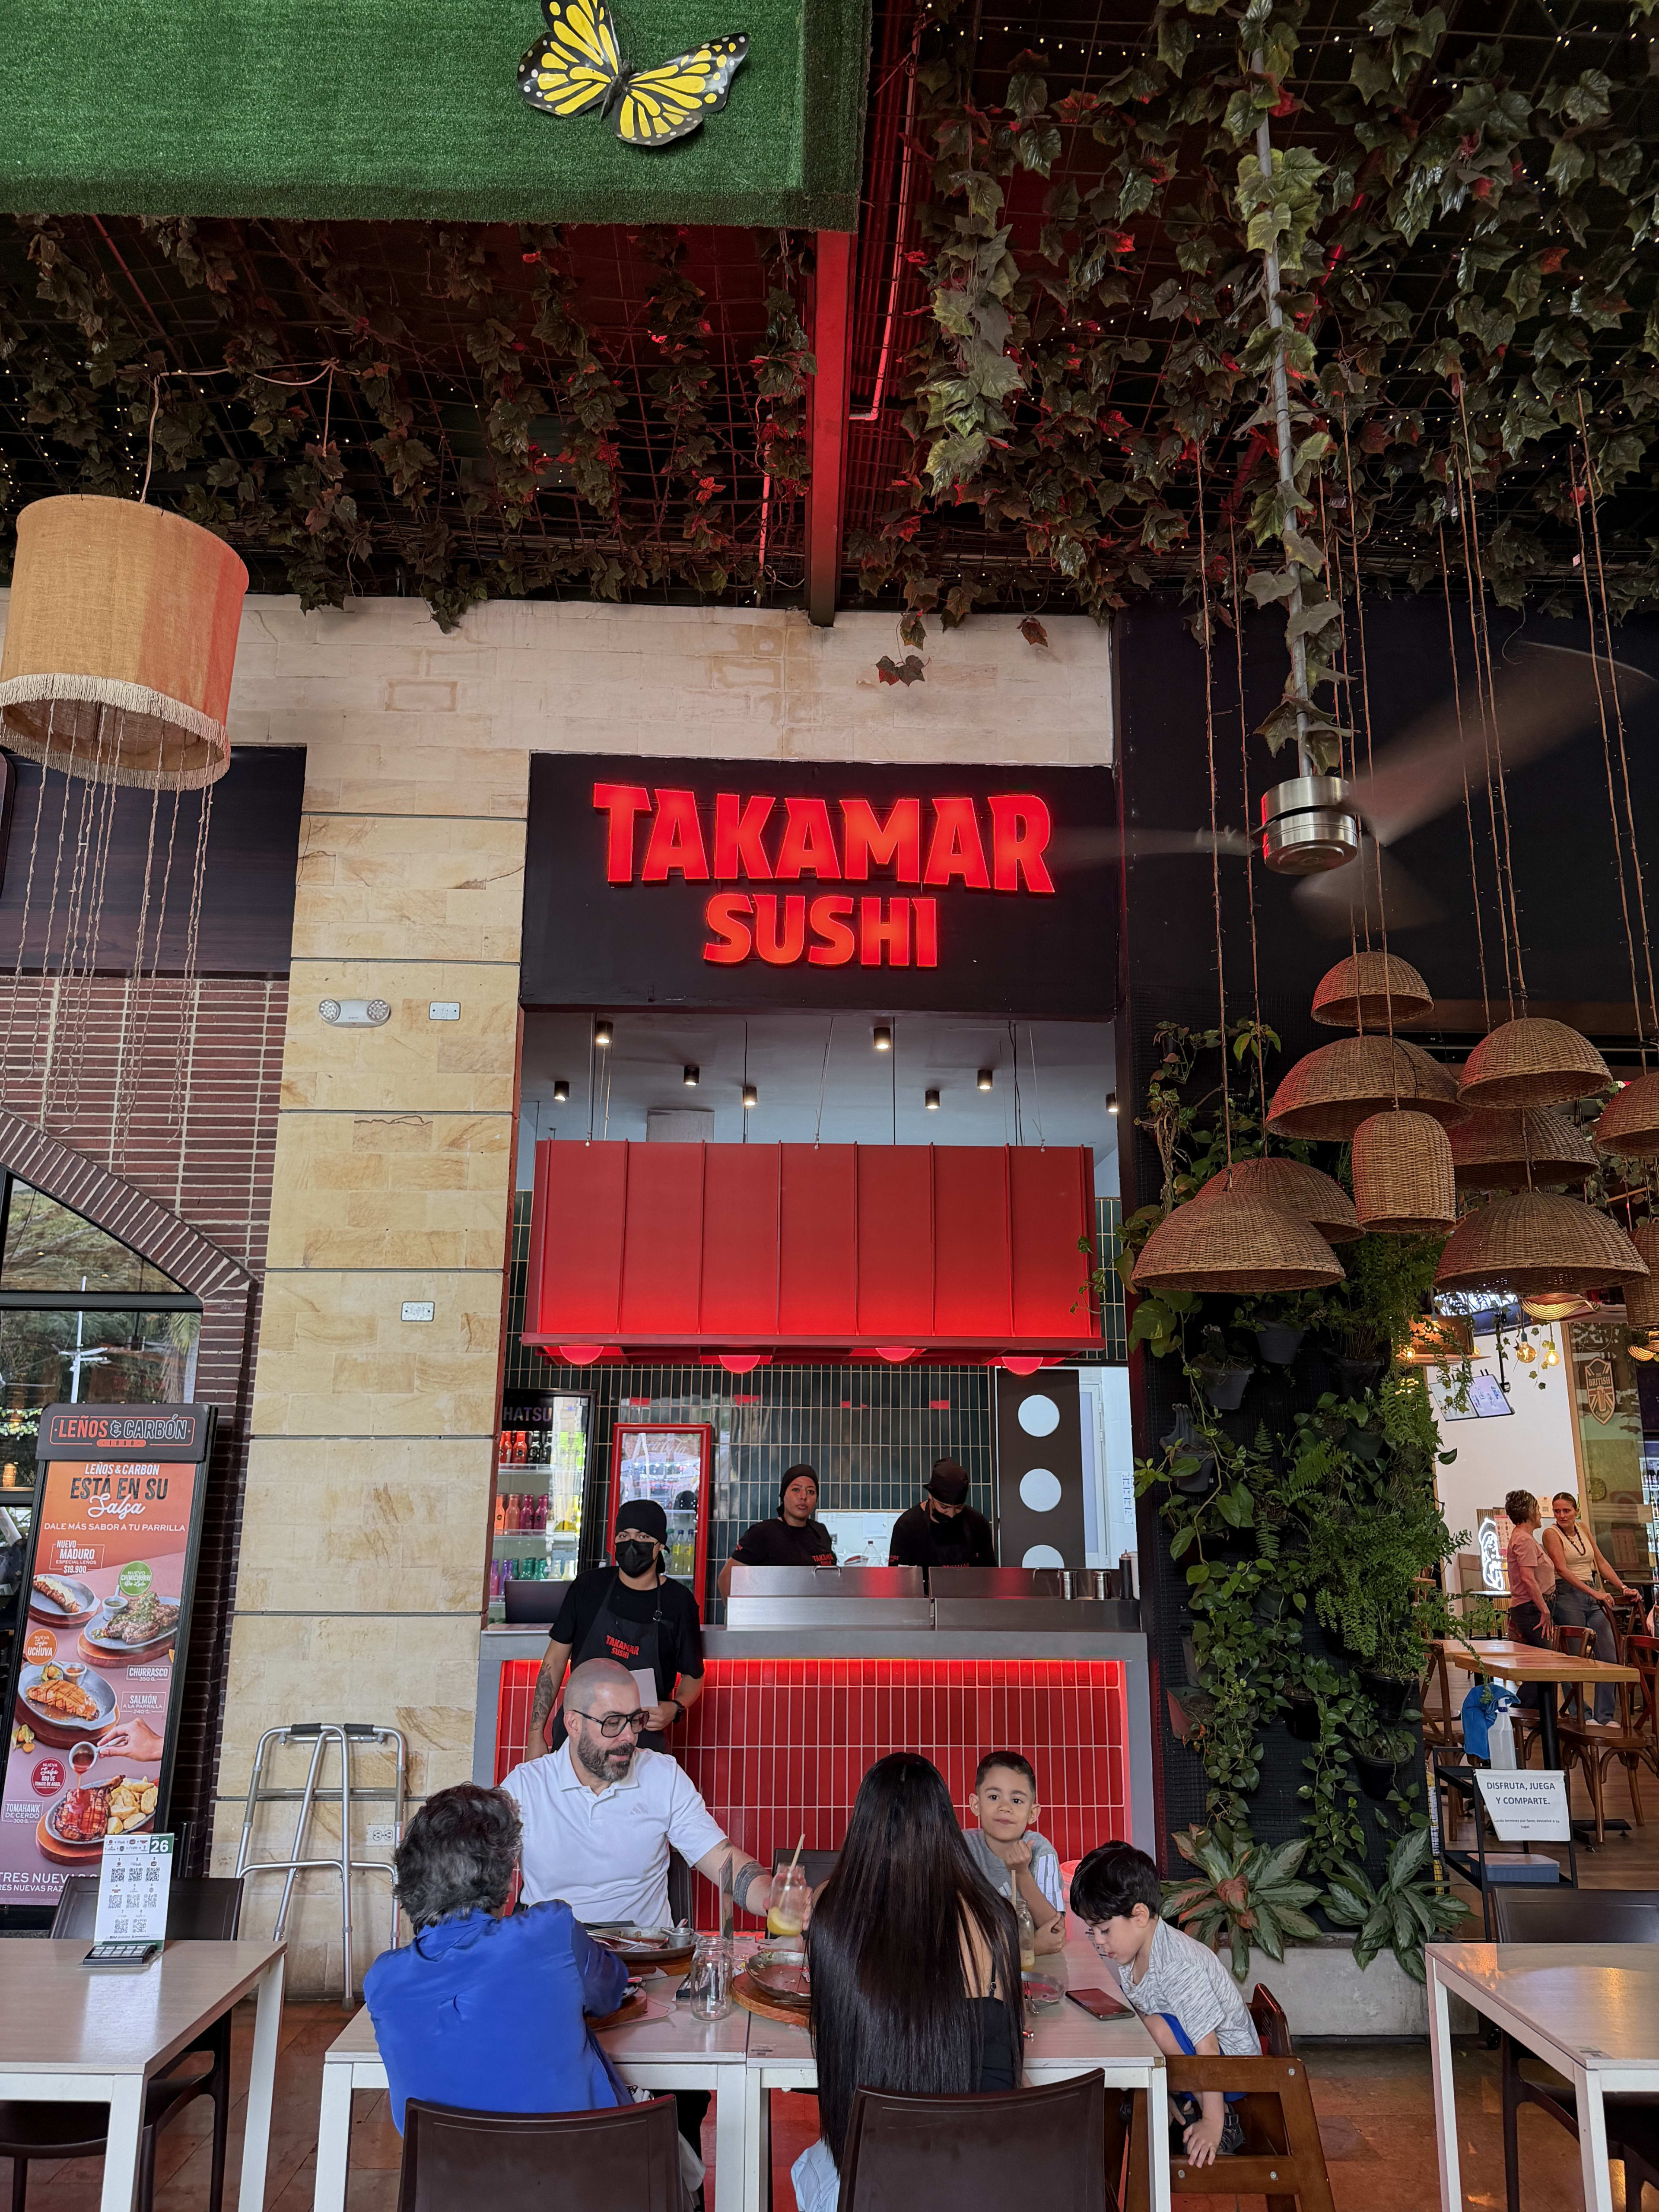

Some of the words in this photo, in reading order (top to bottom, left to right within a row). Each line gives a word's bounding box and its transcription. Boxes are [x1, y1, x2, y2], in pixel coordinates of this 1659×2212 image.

[592, 782, 1055, 894] TAKAMAR
[702, 891, 938, 969] SUSHI
[1589, 1376, 1610, 1386] BRITISH
[503, 1406, 552, 1422] HATSU
[58, 1415, 108, 1438] LEÑOS
[123, 1414, 188, 1440] CARBÓN
[84, 1462, 114, 1475] LEÑOS
[114, 1464, 121, 1474] &
[70, 1475, 111, 1500] ESTÁ
[116, 1478, 141, 1500] EN
[144, 1478, 169, 1500] SU
[87, 1492, 146, 1520] Salsa
[68, 1522, 87, 1531] MÁS
[57, 1540, 76, 1548] NUEVO
[59, 1548, 95, 1560] MADURO
[63, 1565, 87, 1574] $19.900
[27, 1646, 53, 1656] UCHUVA
[606, 1634, 639, 1656] TAKAMAR
[611, 1647, 629, 1659] SUSHI
[129, 1667, 168, 1677] CHURRASCO
[130, 1694, 157, 1704] SALMÓN
[1487, 1782, 1527, 1791] DISFRUTA,
[6, 1803, 41, 1813] TOMAHAWK
[150, 1840, 169, 1853] 26
